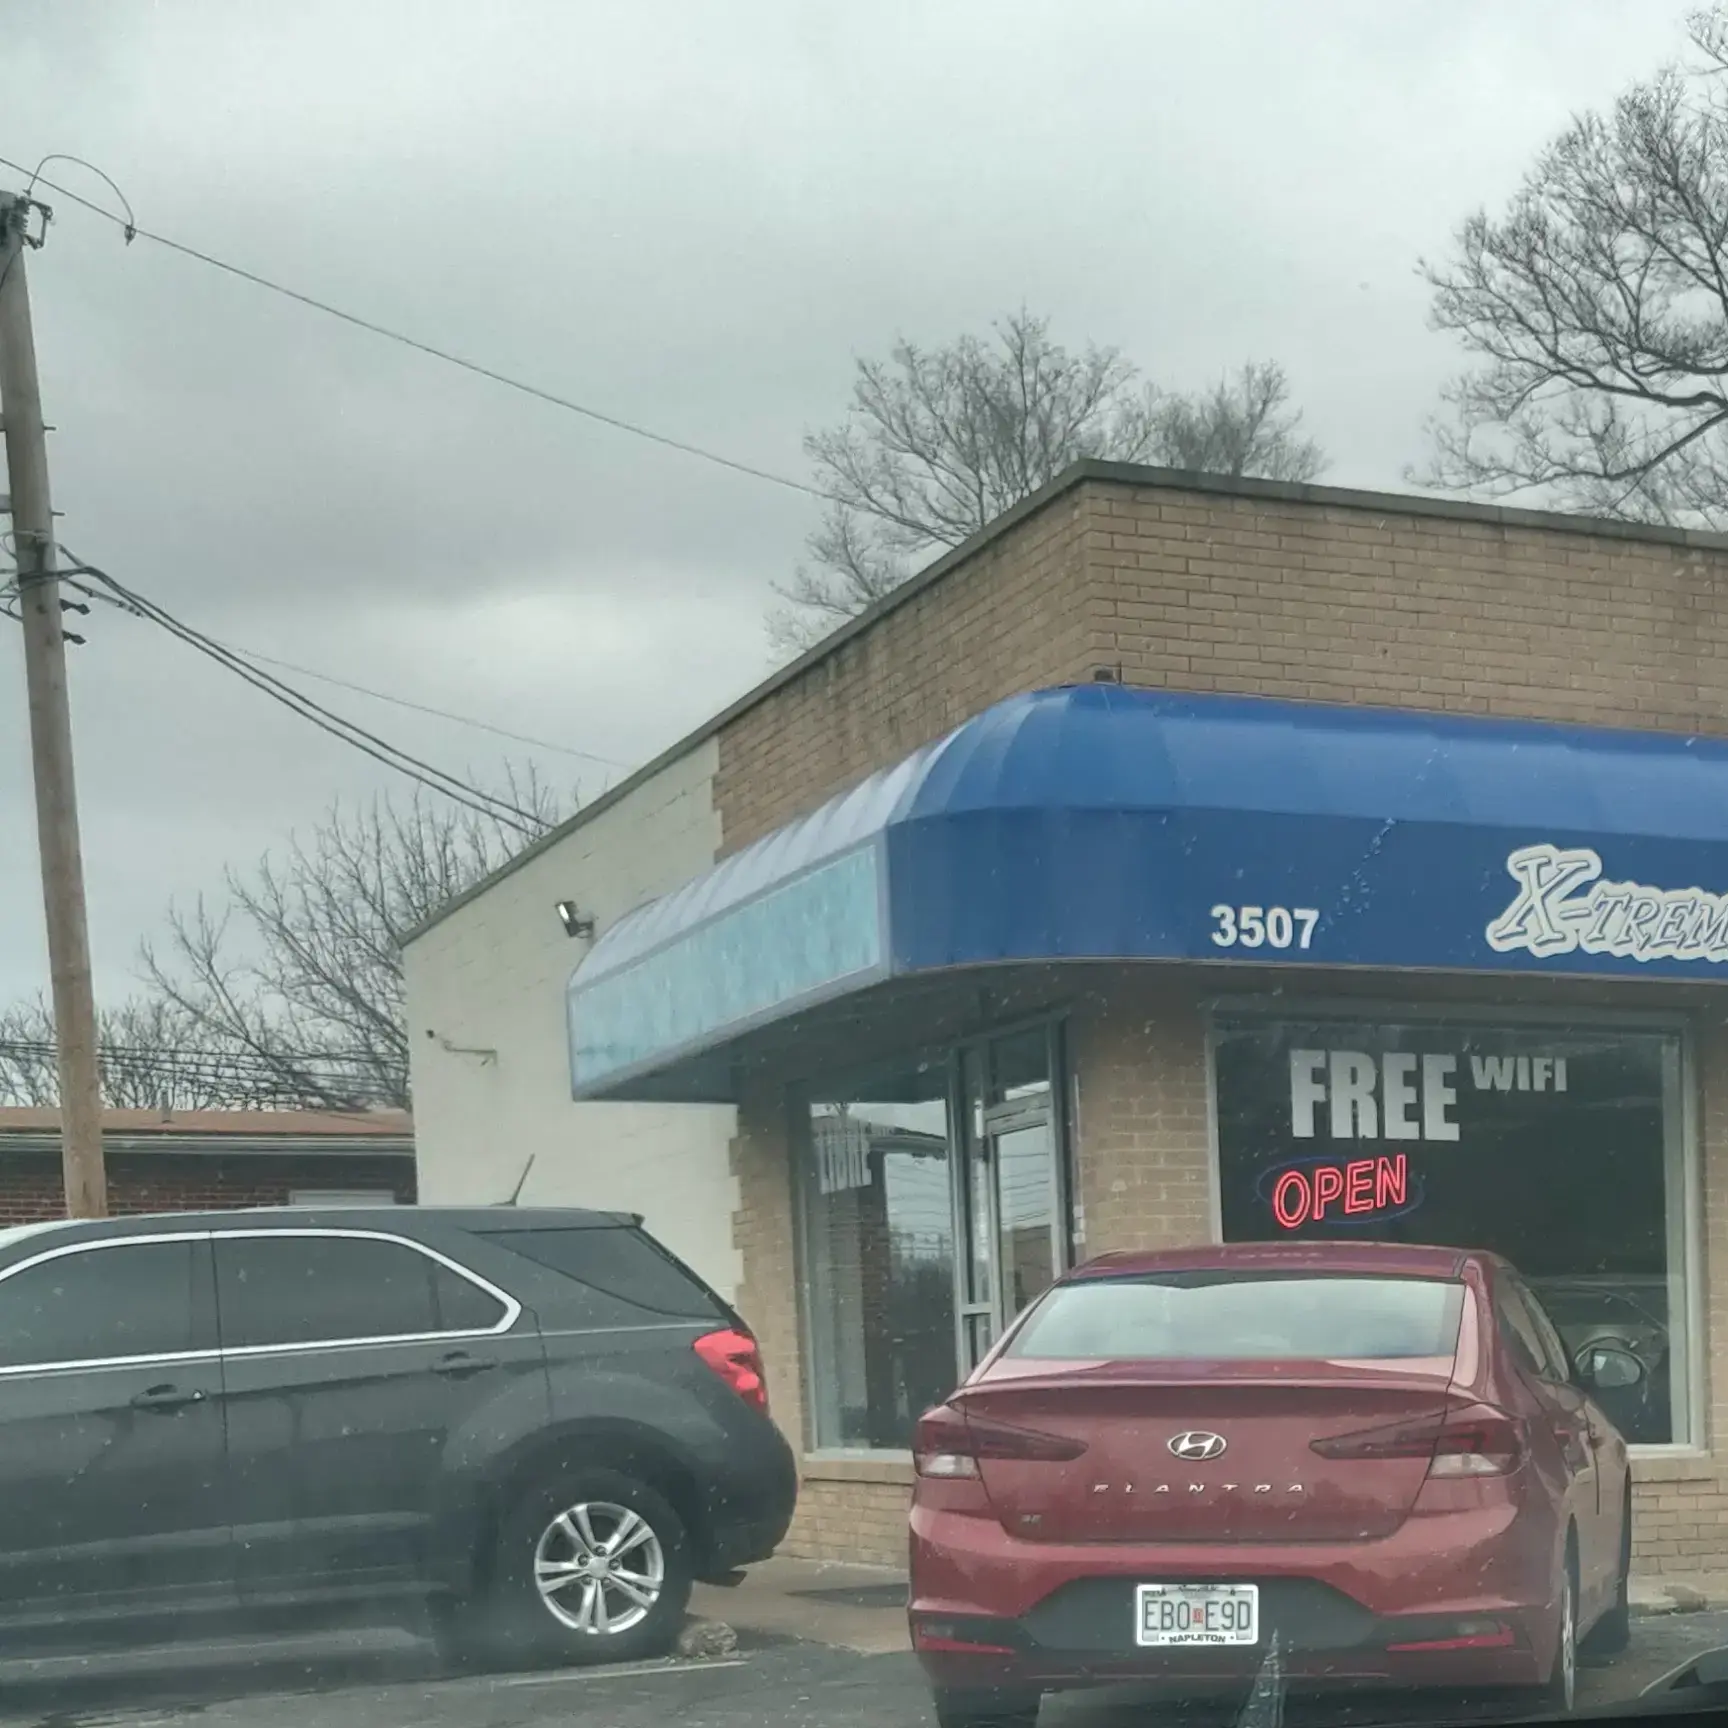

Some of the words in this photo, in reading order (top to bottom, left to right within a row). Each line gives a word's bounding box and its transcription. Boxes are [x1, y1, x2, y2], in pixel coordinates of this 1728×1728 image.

[1210, 905, 1320, 951] 3507
[1290, 1050, 1460, 1141] FREE
[1470, 1055, 1567, 1092] WIFI
[1273, 1154, 1407, 1229] OPEN
[1093, 1483, 1304, 1494] ELANTRA
[1168, 1633, 1227, 1644] NAPLETON
